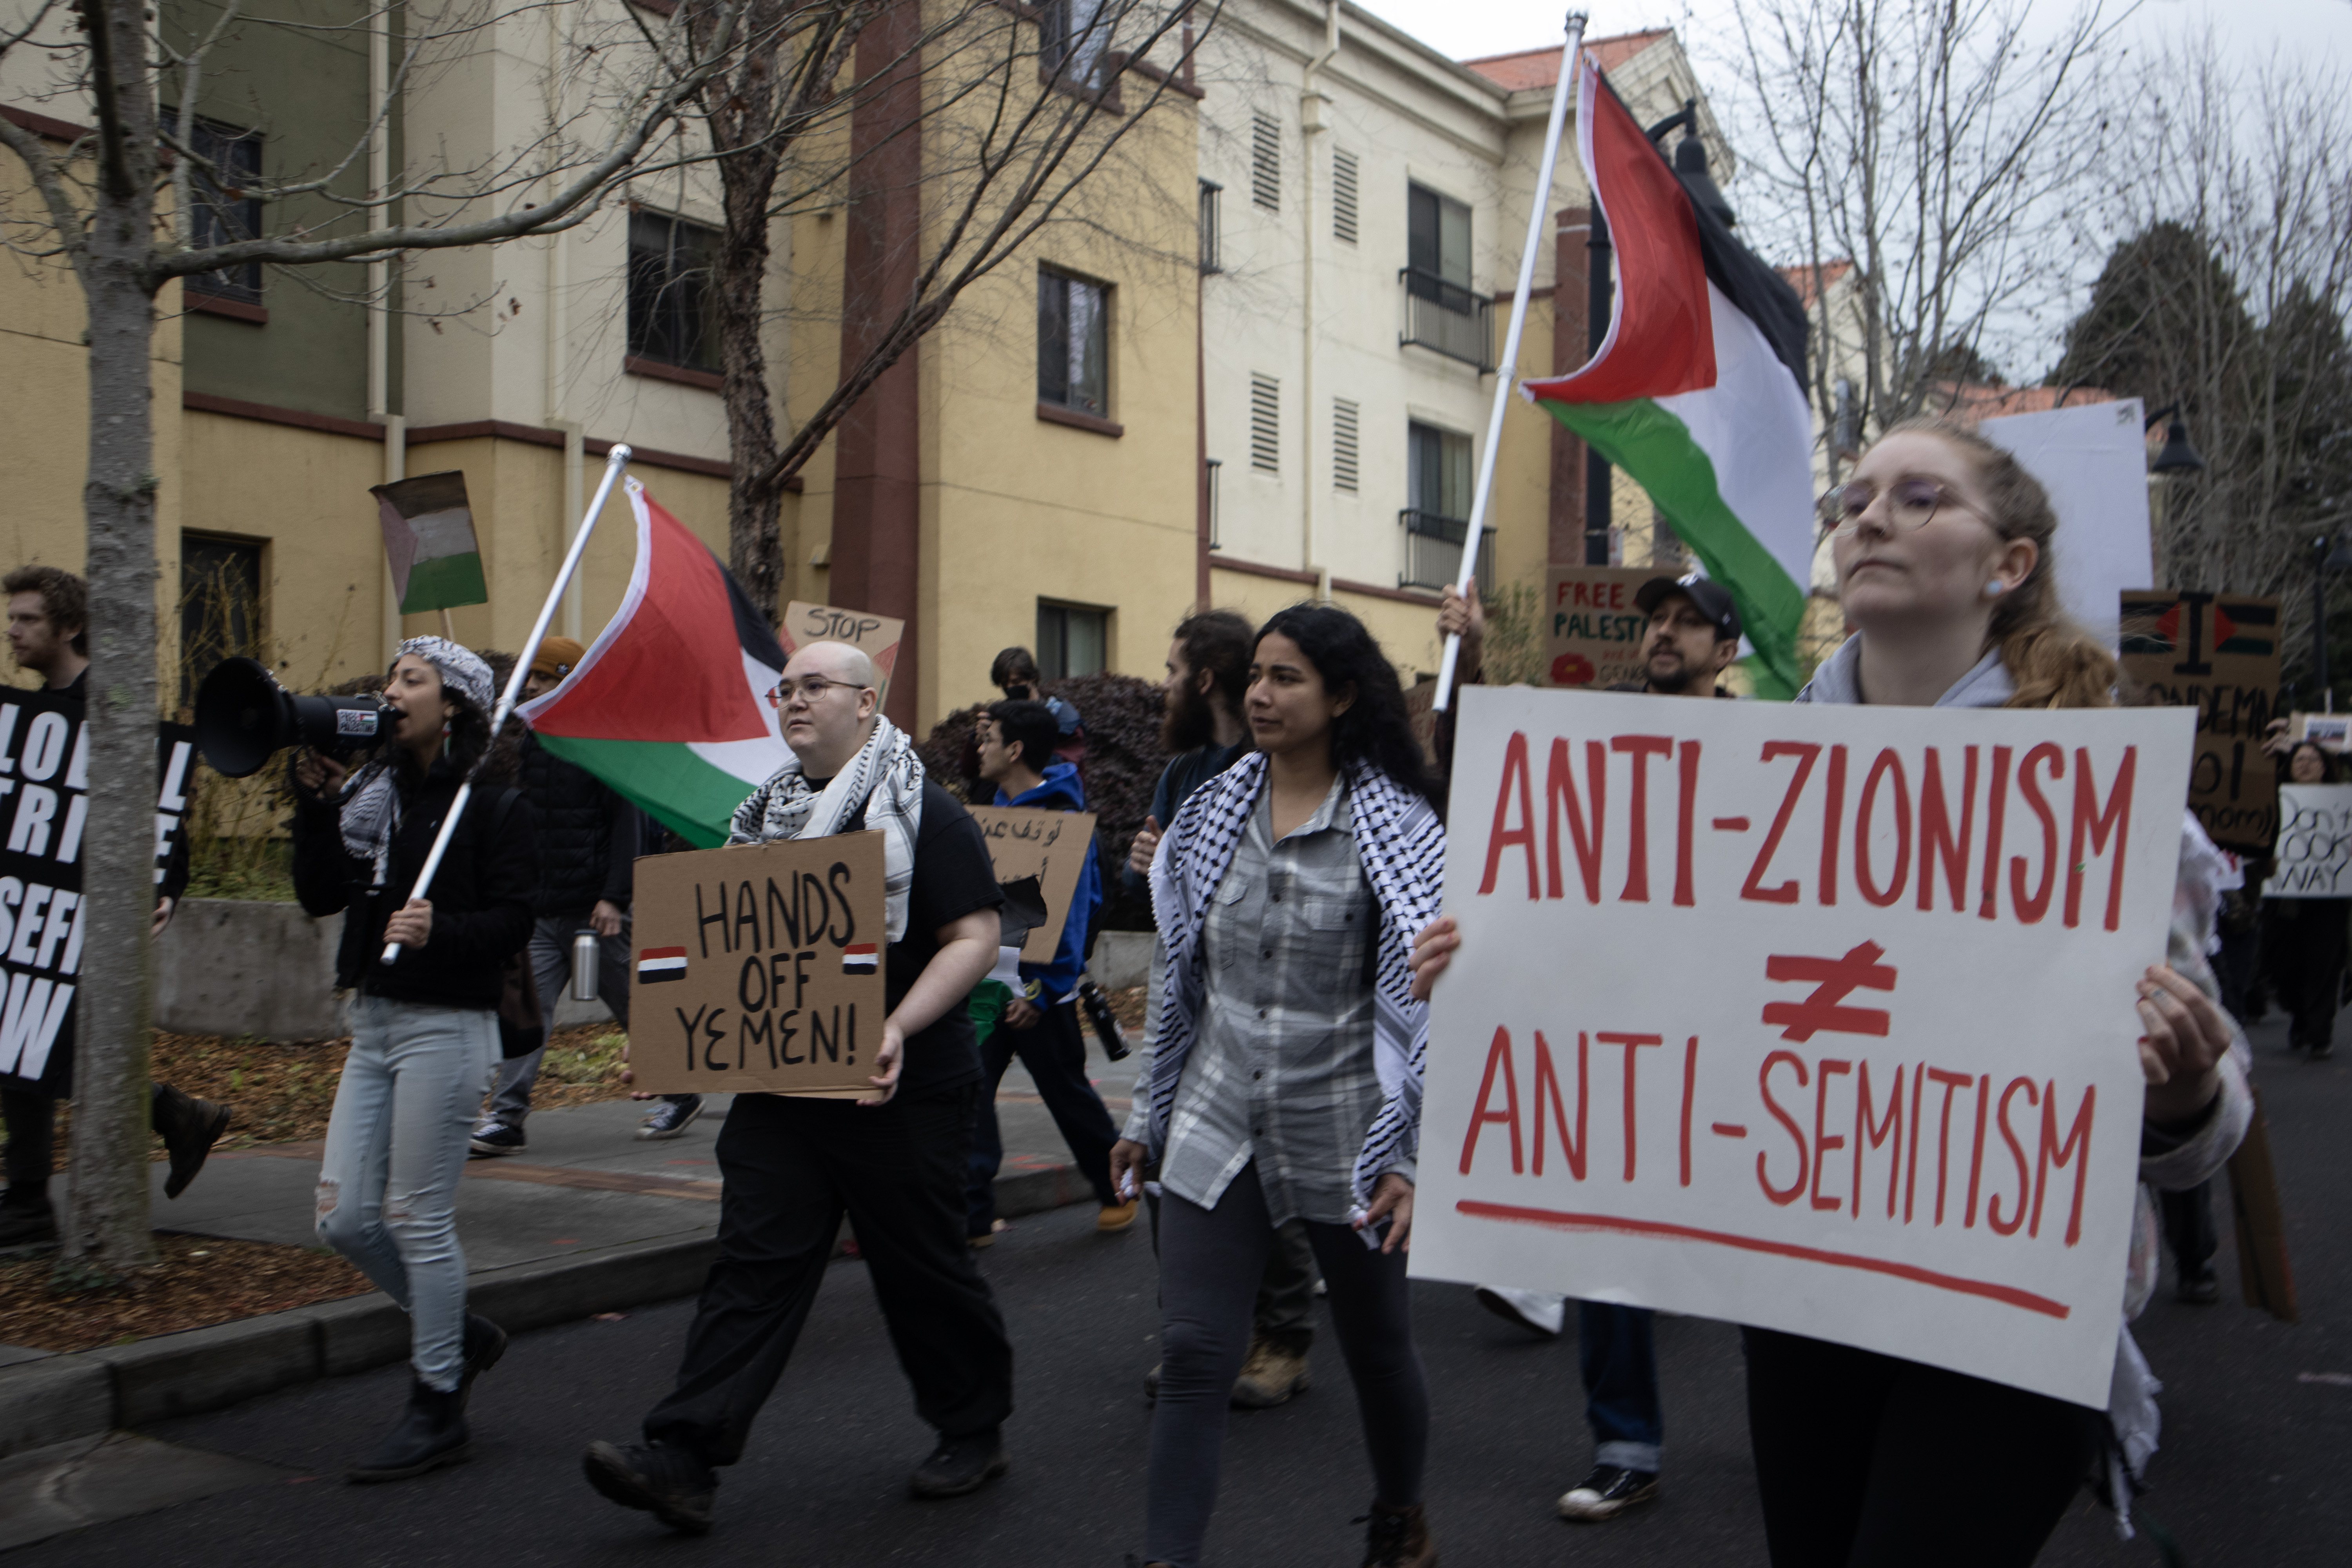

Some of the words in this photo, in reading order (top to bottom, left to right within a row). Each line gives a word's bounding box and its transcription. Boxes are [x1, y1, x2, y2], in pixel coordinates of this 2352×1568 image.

[803, 608, 881, 642] STOP
[1557, 581, 1625, 610] FREE
[2174, 592, 2214, 675] I
[1478, 731, 2137, 932] ANTI-ZIONISM
[2283, 831, 2352, 863] OOK
[2273, 857, 2349, 892] WAY
[695, 862, 855, 958] HANDS
[739, 951, 817, 1012] OFF
[675, 1003, 857, 1071] YEMEN!
[1459, 1024, 2097, 1247] ANTI-SEMITISM
